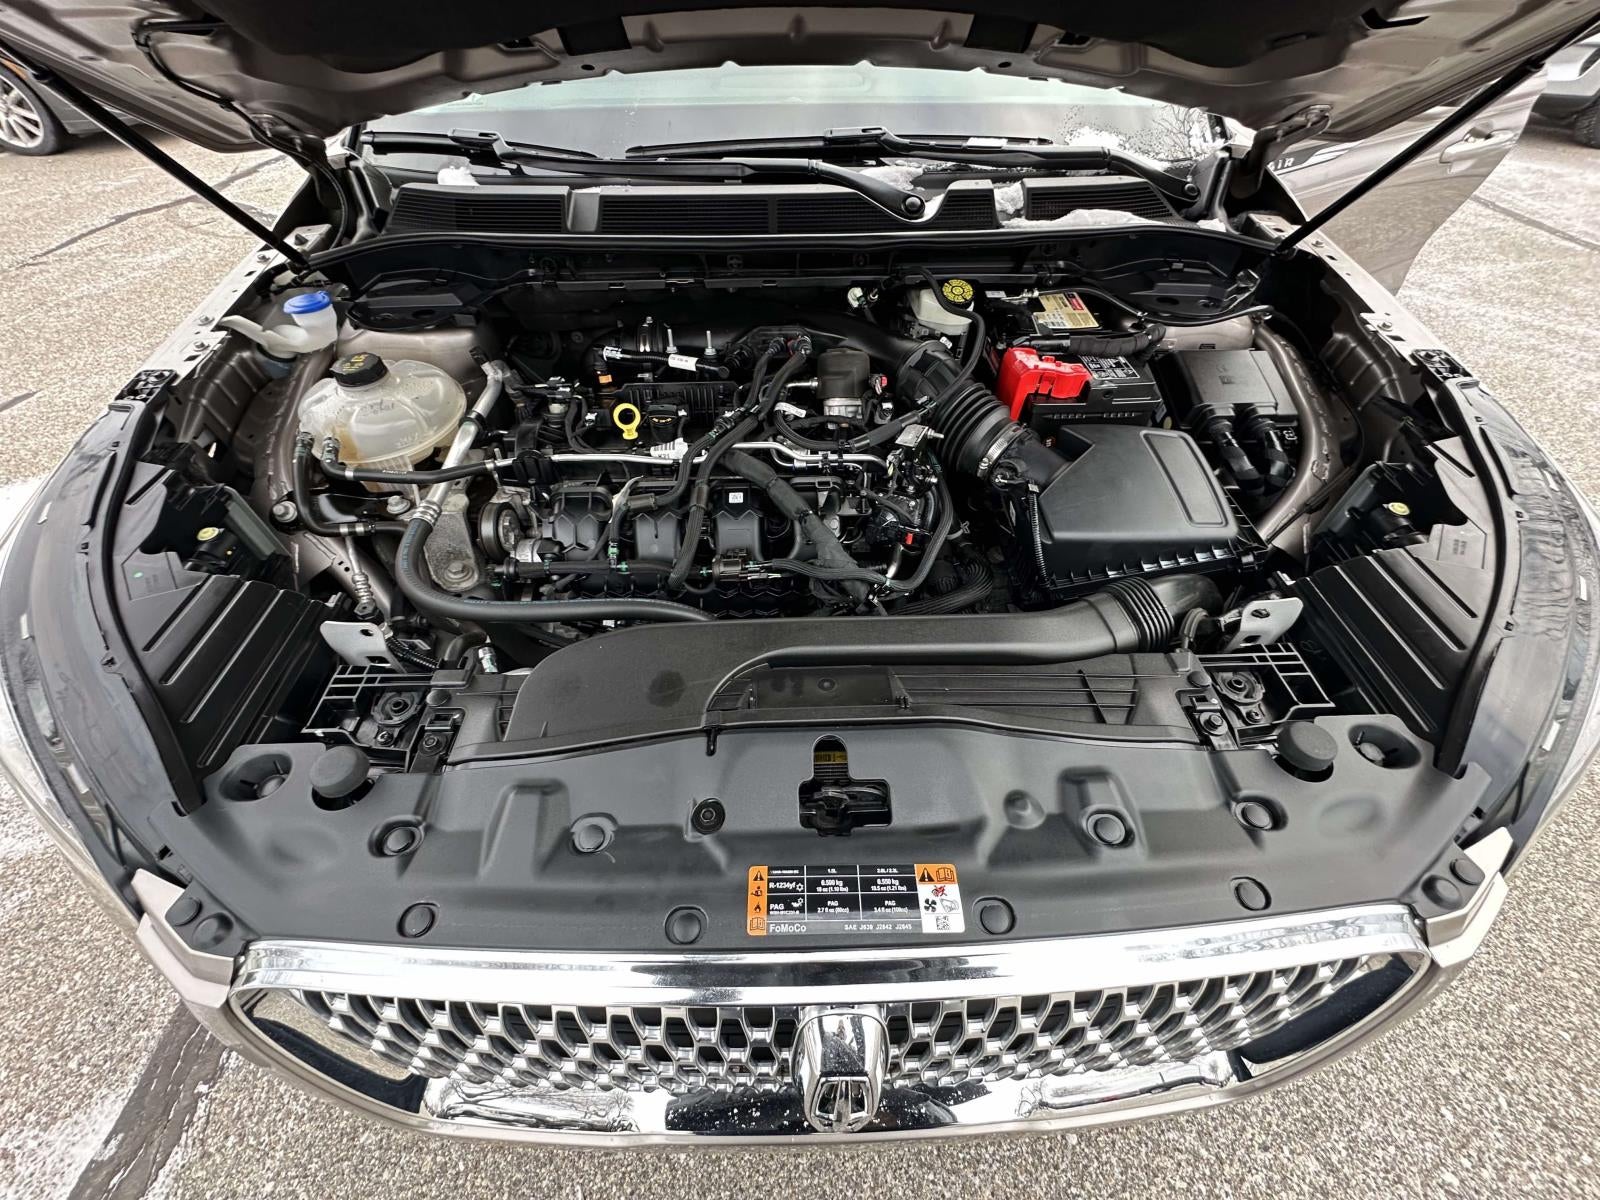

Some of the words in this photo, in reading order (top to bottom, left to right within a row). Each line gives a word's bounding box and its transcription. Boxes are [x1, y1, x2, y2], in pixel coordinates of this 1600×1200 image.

[768, 881, 796, 890] R-1234yf
[835, 879, 844, 887] kg
[891, 878, 899, 886] kg
[769, 923, 807, 933] FoMoCo
